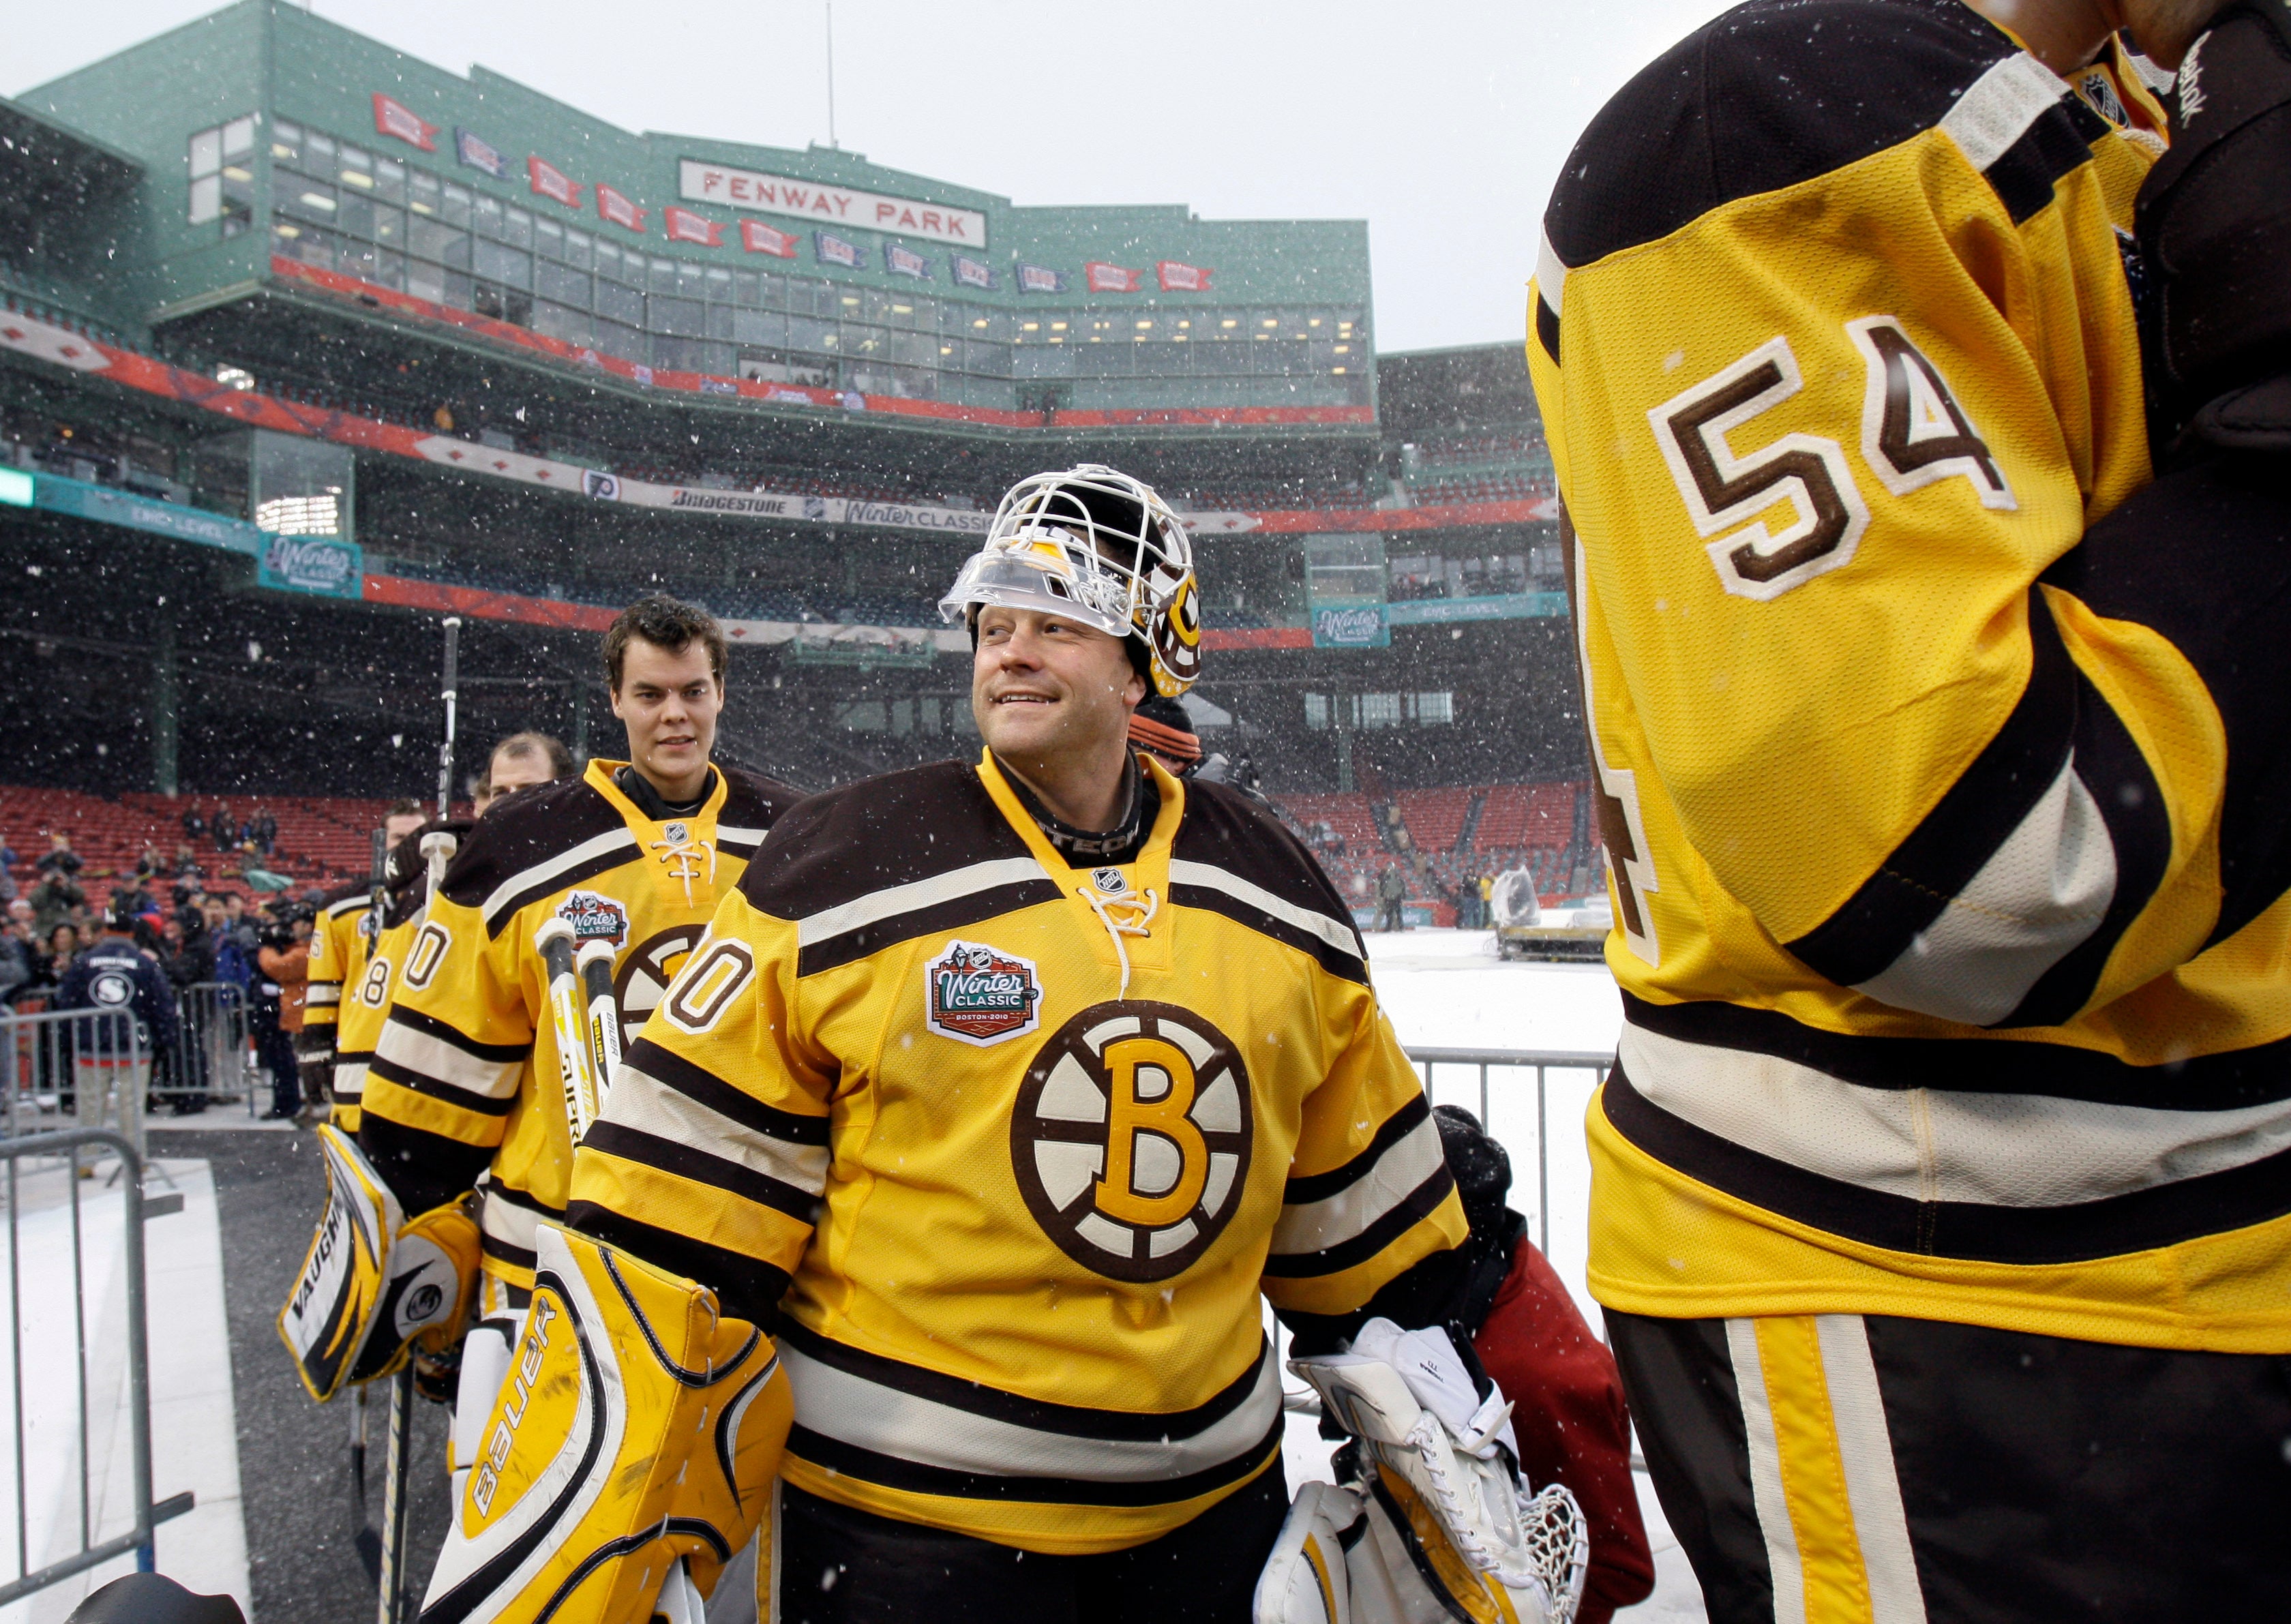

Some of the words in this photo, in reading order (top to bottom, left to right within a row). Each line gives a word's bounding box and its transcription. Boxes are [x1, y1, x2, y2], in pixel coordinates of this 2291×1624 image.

[703, 172, 852, 217] FENWAY
[875, 202, 966, 237] PARK
[1647, 315, 2017, 601] 54
[672, 490, 785, 514] BRIDGESTONE
[844, 499, 914, 524] Winter
[273, 537, 348, 576] Winter
[1321, 609, 1379, 637] Winter
[1102, 871, 1119, 888] NHL
[564, 909, 618, 927] Winter
[575, 926, 616, 935] CLASSIC
[351, 957, 392, 1009] 8
[938, 969, 1024, 1009] Winter
[955, 995, 1021, 1006] CLASSIC
[607, 1012, 618, 1057] BAUER
[473, 1296, 556, 1519] BAUER
